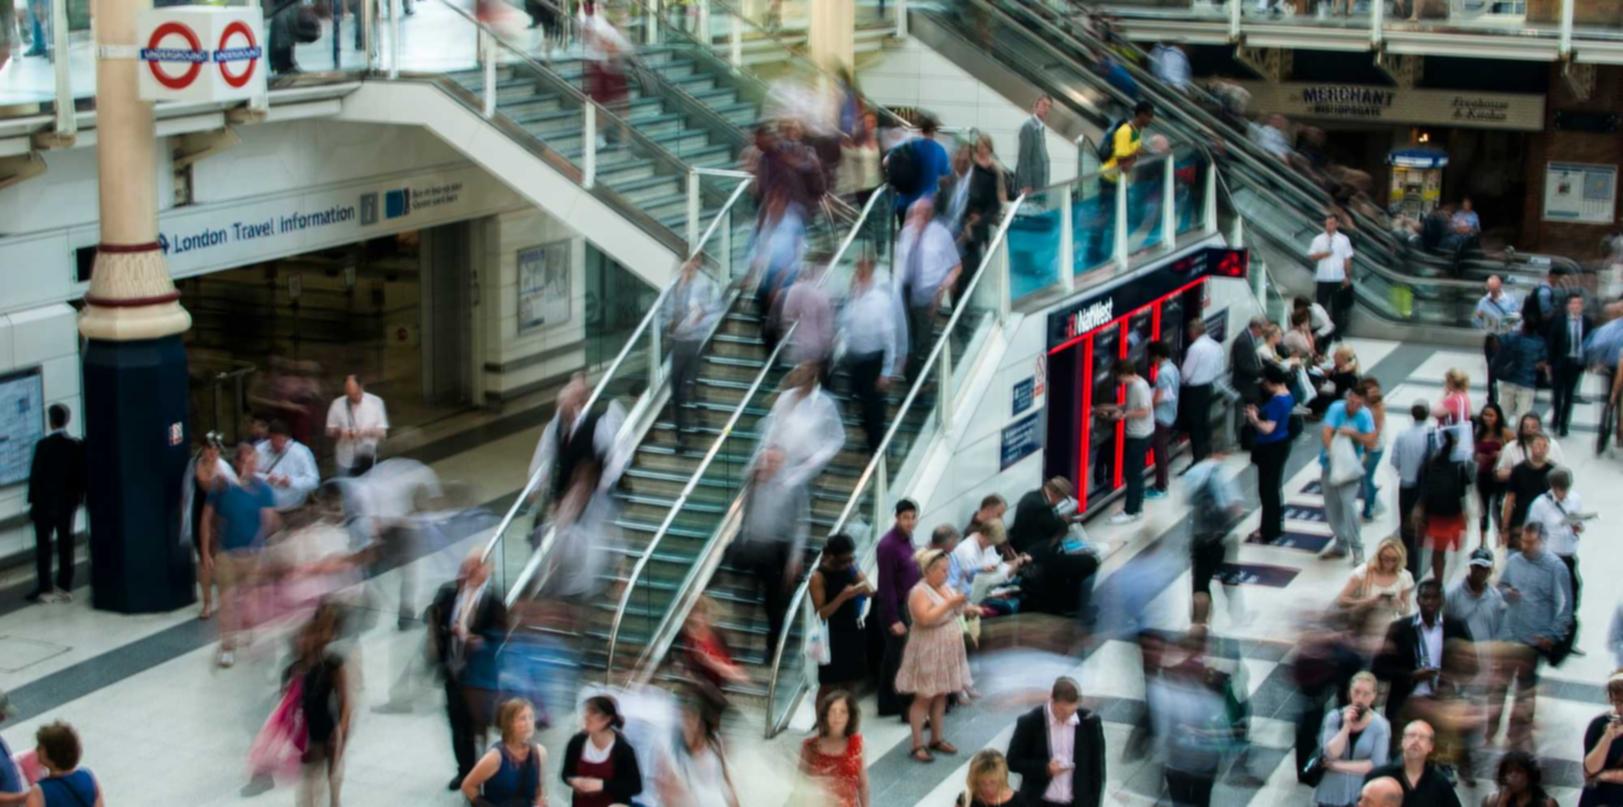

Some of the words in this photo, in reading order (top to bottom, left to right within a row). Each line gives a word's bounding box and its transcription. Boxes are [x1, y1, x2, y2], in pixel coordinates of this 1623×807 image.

[1303, 86, 1394, 107] MERCHANT
[174, 228, 228, 253] London
[233, 217, 275, 240] Travel
[1078, 296, 1113, 335] NatWest
